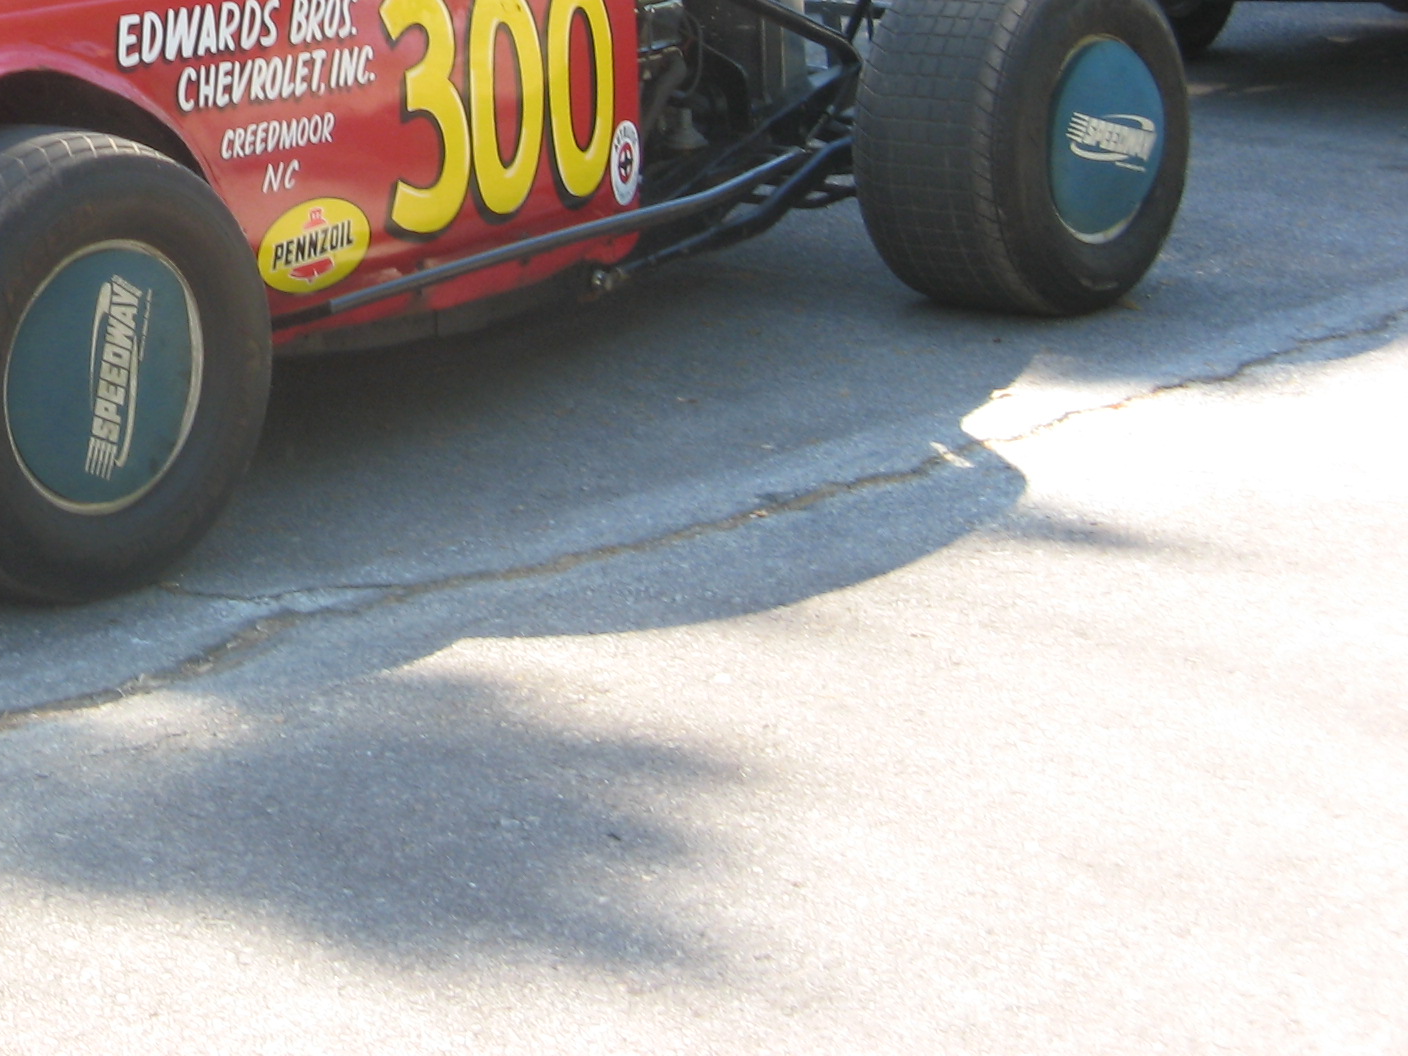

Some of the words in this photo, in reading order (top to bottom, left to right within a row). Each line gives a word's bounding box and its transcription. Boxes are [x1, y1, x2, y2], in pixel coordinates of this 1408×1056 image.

[329, 44, 376, 89] INC.
[220, 111, 335, 160] CREEDMOOR
[262, 158, 300, 194] NC
[271, 219, 354, 271] PENNZOIL
[92, 278, 141, 445] SPEEDWAY
